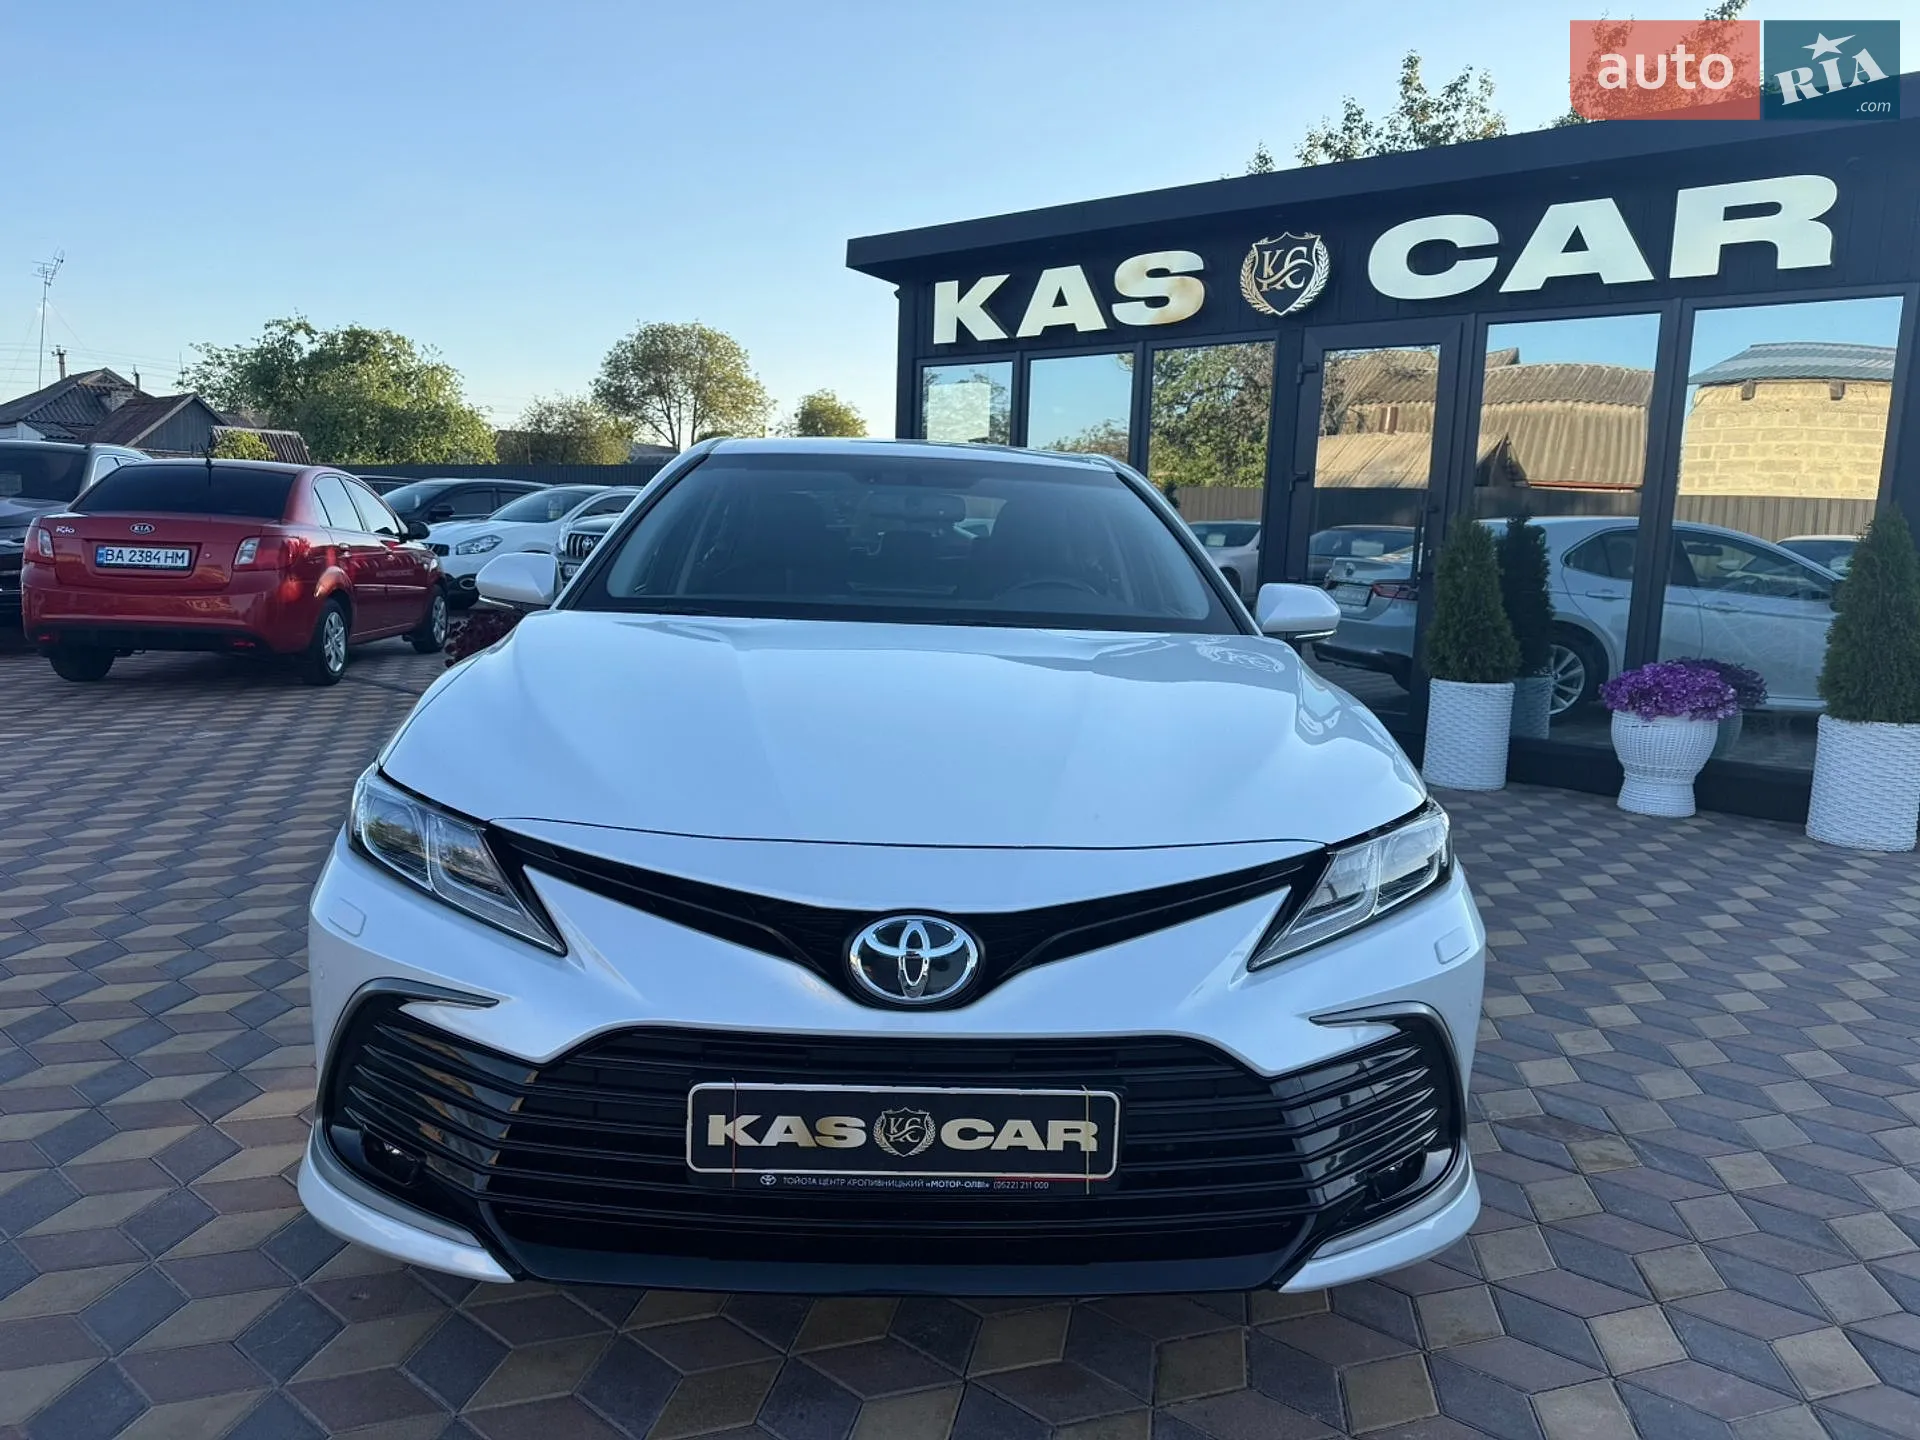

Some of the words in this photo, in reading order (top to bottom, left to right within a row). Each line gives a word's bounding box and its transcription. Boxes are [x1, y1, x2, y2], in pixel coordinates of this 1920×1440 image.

[932, 249, 1206, 345] KAS
[1367, 174, 1838, 300] CAR
[133, 524, 151, 532] KIA
[105, 549, 125, 562] BA
[128, 550, 161, 563] 2384
[163, 551, 186, 564] HM
[707, 1113, 866, 1149] KAS
[940, 1117, 1098, 1152] CAR
